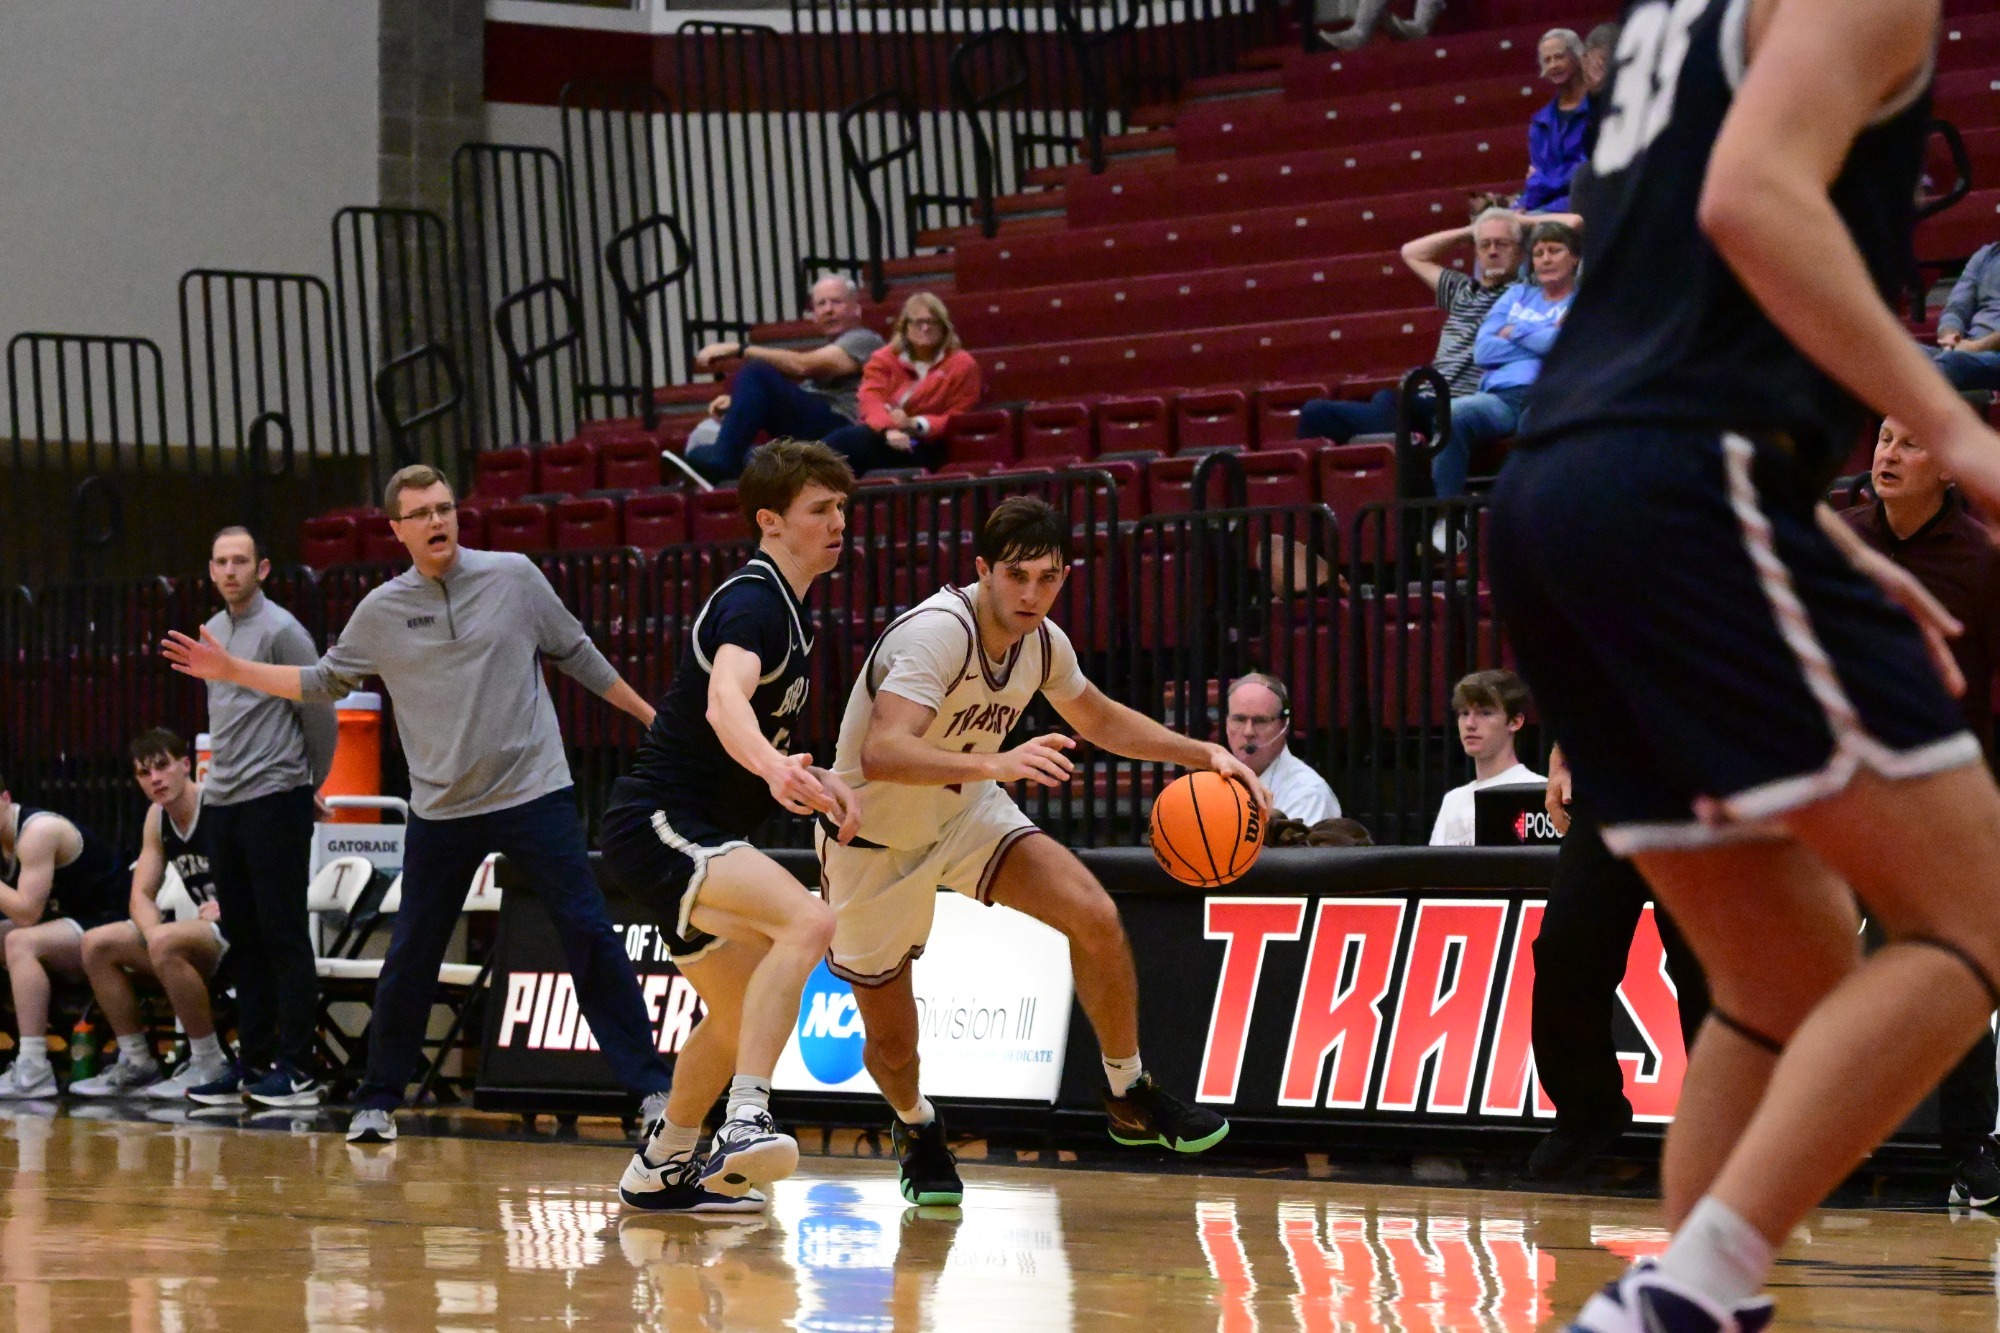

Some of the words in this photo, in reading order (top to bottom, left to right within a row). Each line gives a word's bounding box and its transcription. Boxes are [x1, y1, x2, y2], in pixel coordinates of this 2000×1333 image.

[943, 703, 1020, 738] TRANSY
[1525, 812, 1565, 838] POS
[328, 840, 398, 853] GATORADE
[625, 924, 652, 961] OF
